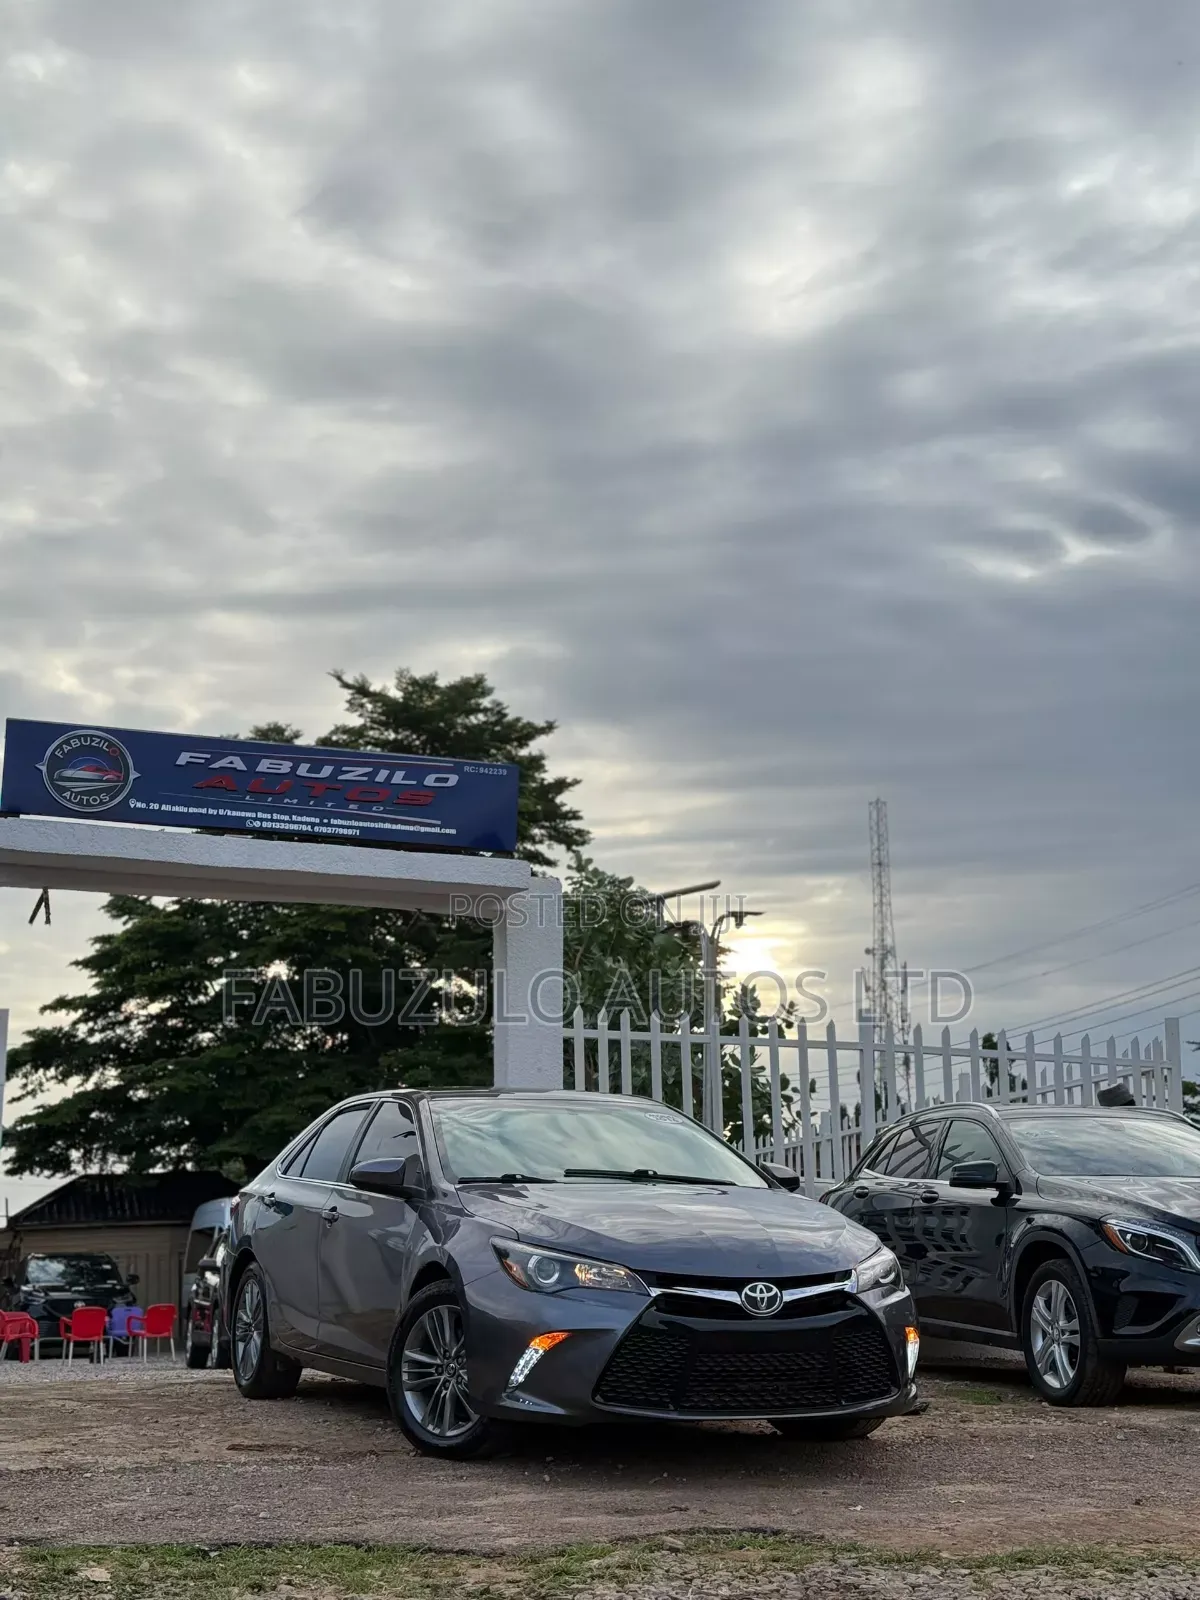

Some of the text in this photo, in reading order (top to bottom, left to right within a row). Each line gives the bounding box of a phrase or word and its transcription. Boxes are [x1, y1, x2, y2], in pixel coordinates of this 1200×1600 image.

[55, 736, 119, 758] FABUZILO
[175, 752, 459, 788] FABUZILO
[62, 791, 110, 805] AUTOS
[191, 774, 436, 806] AUTOS
[136, 801, 148, 810] No.
[149, 802, 159, 810] 20
[208, 807, 218, 816] by
[292, 815, 320, 823] Kaduna
[244, 795, 384, 811] LIMITED
